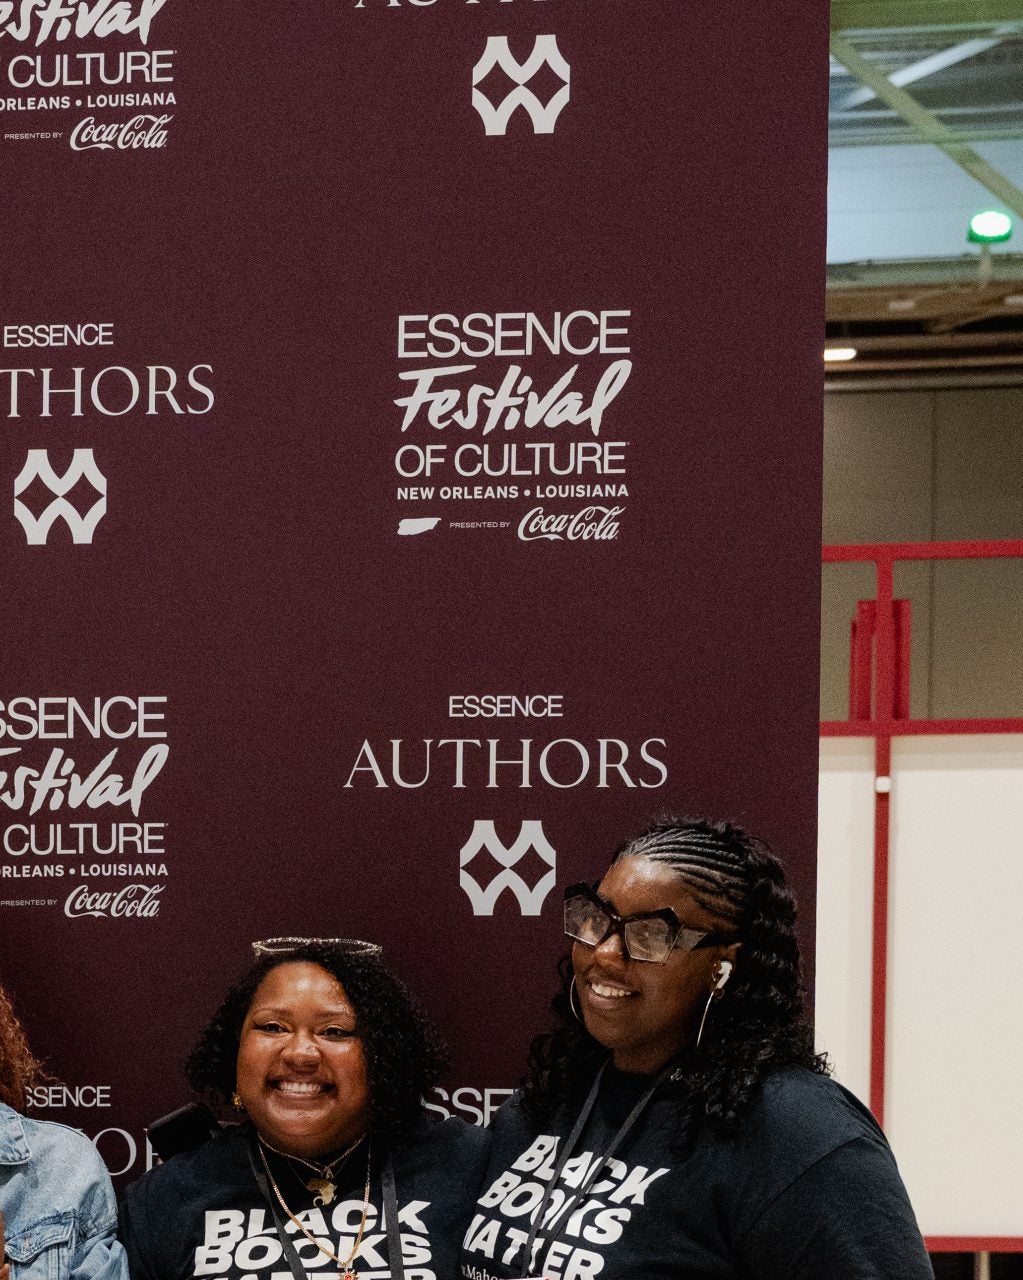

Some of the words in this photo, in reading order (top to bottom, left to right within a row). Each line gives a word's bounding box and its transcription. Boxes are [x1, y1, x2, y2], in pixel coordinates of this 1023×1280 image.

[8, 50, 173, 87] CULTURE
[88, 92, 176, 107] LOUISIANA
[4, 132, 51, 140] PRESENTED
[52, 131, 63, 139] BY
[70, 114, 174, 150] Coca-Cola
[4, 324, 113, 347] ESSENCE
[398, 310, 631, 358] ESSENCE
[394, 360, 632, 436] Festival
[395, 445, 446, 477] OF
[455, 442, 626, 476] CULTURE
[398, 487, 434, 499] NEW
[440, 486, 518, 499] ORLEANS
[537, 484, 628, 498] LOUISIANA
[449, 521, 498, 529] PRESENTED
[518, 506, 626, 541] Coca-Cola
[449, 695, 563, 717] ESSENCE
[343, 738, 667, 788] AUTHORS
[4, 823, 164, 855] CULTURE
[81, 864, 168, 876] LOUISIANA
[0, 899, 45, 907] PRESENTED
[64, 885, 166, 917] Coca-Cola
[25, 1085, 112, 1108] SSENCE
[511, 1135, 671, 1206] BLACK
[205, 1199, 432, 1250] BLACK
[193, 1234, 434, 1277] BOOKS
